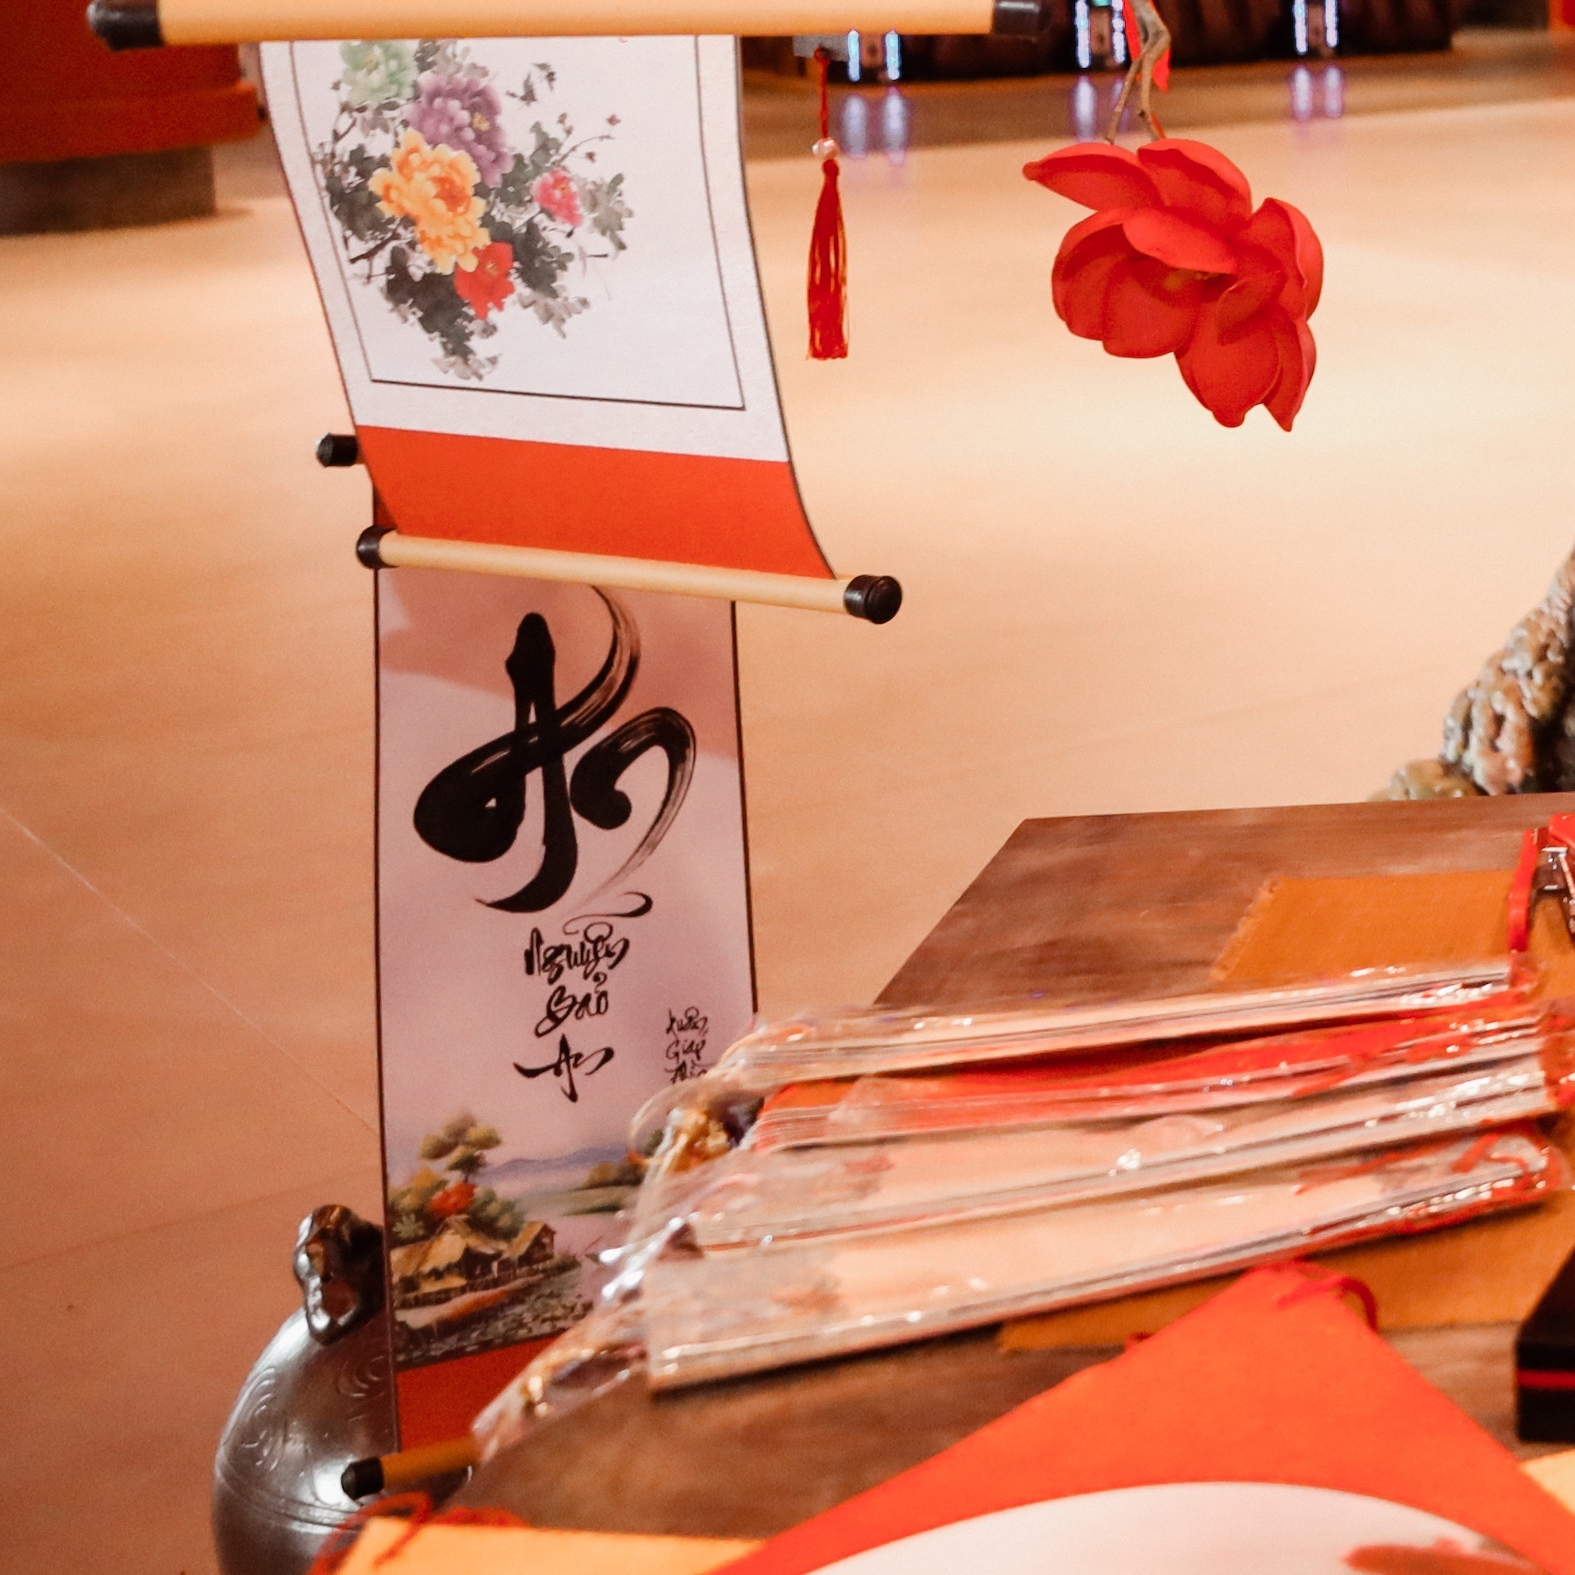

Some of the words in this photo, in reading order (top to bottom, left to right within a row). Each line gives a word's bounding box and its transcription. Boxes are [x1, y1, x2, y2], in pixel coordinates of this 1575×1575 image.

[414, 587, 696, 914] An
[524, 891, 653, 984] Nguyễn
[534, 972, 609, 1037] Bảo
[666, 1006, 709, 1037] Xuân
[513, 1033, 616, 1103] An
